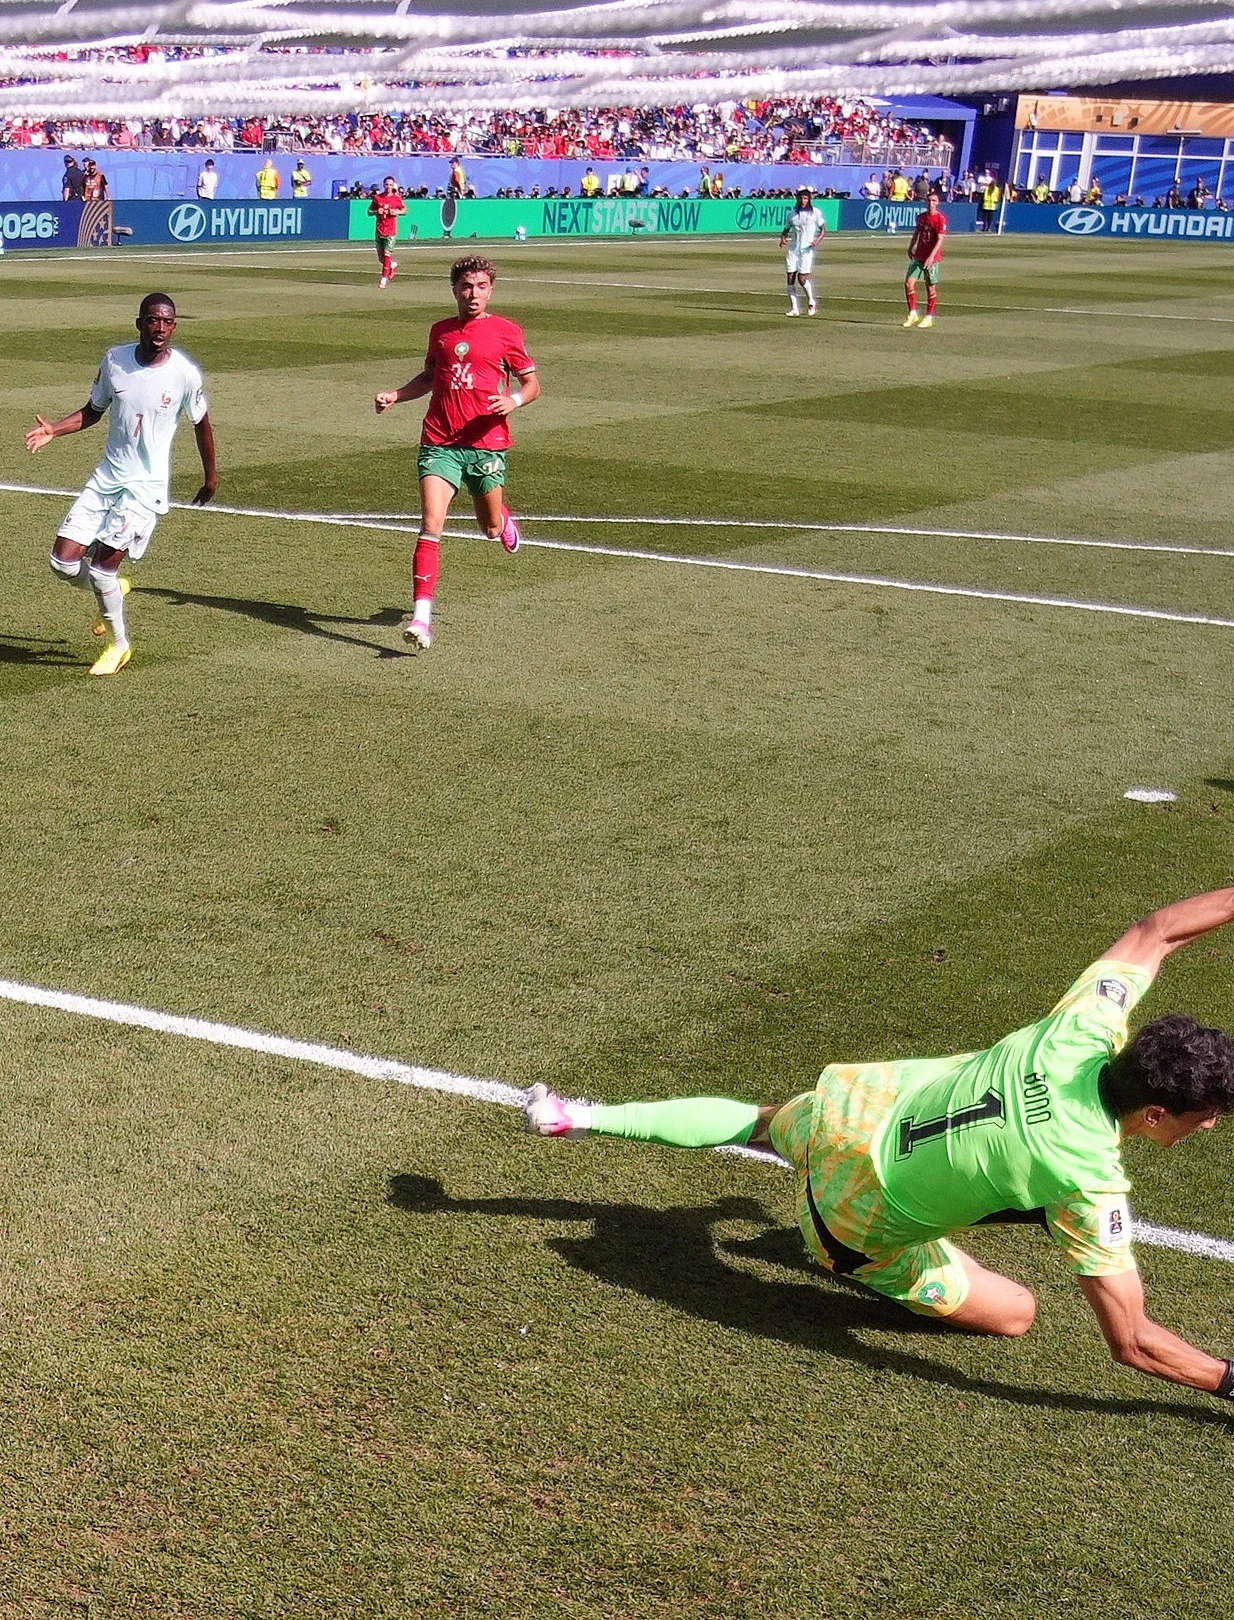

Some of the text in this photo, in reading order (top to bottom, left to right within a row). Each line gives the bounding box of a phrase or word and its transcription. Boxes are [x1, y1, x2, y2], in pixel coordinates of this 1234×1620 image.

[0, 212, 53, 240] 026
[211, 207, 302, 236] HYUNDAI
[885, 206, 928, 228] HYUND
[1111, 211, 1234, 238] HYUNDAI
[134, 413, 144, 438] 7
[1023, 1072, 1052, 1125] BONO
[895, 1086, 1006, 1163] 1
